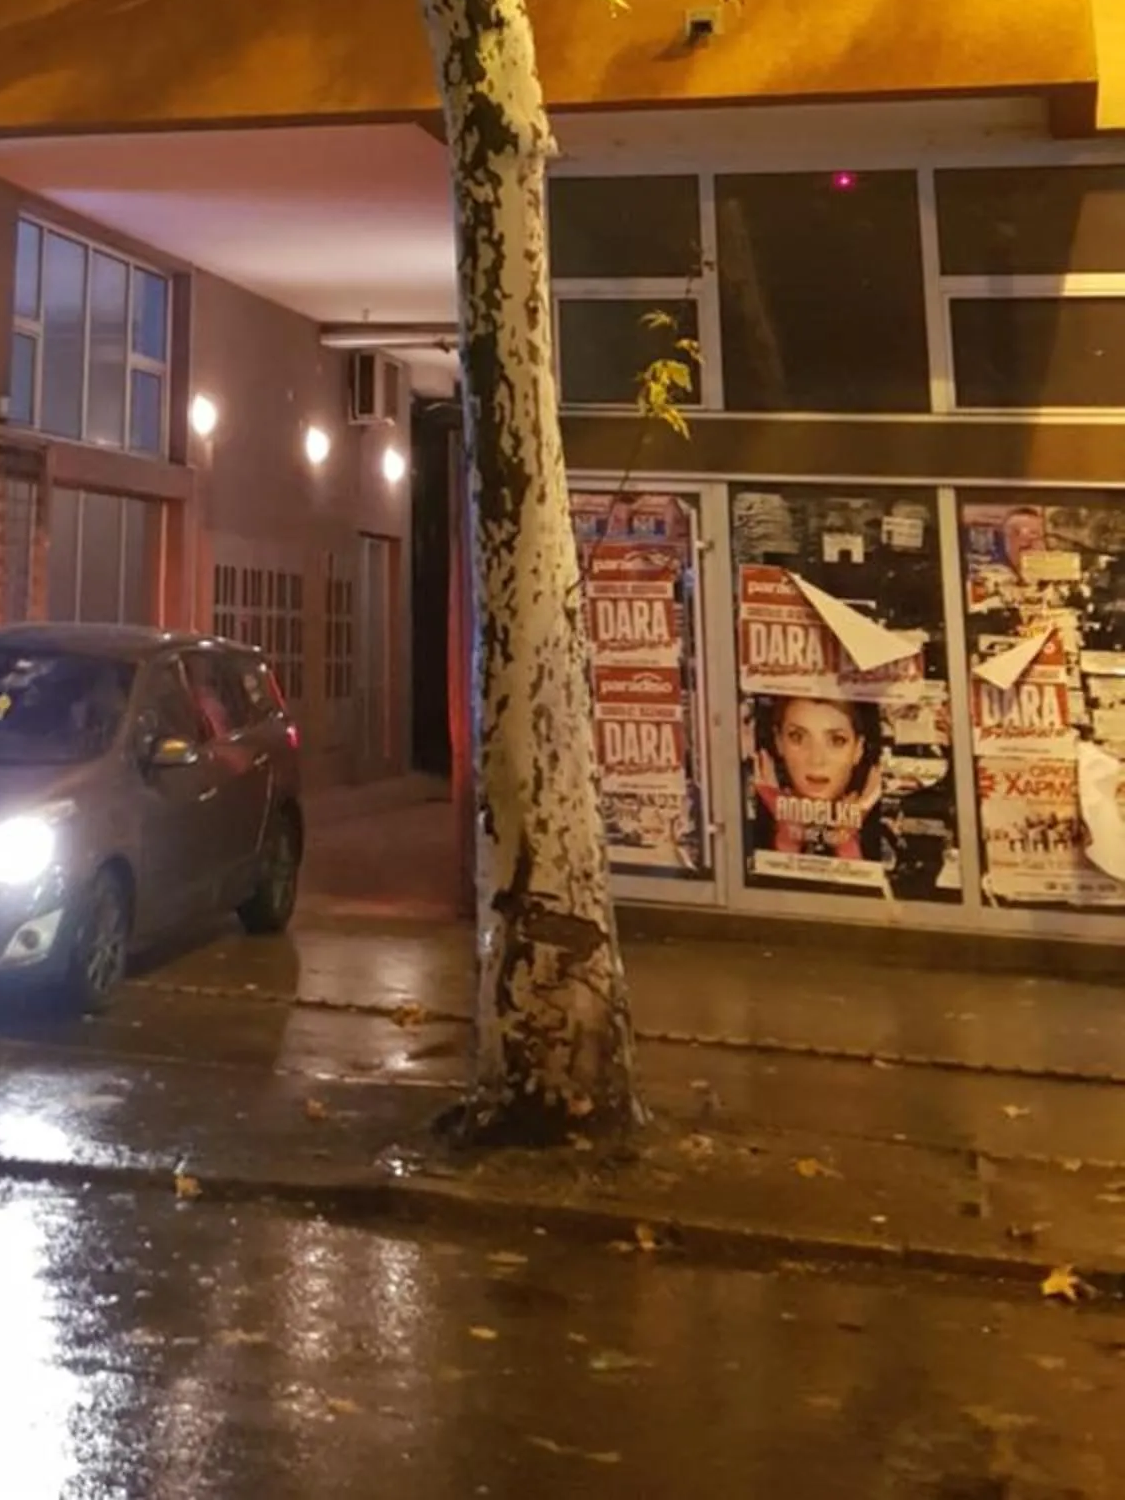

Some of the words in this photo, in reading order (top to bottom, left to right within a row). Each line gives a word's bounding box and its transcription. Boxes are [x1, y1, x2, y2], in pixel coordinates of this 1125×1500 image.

[596, 599, 671, 641] DARA
[748, 622, 825, 670] DARA
[603, 721, 678, 766] DARA
